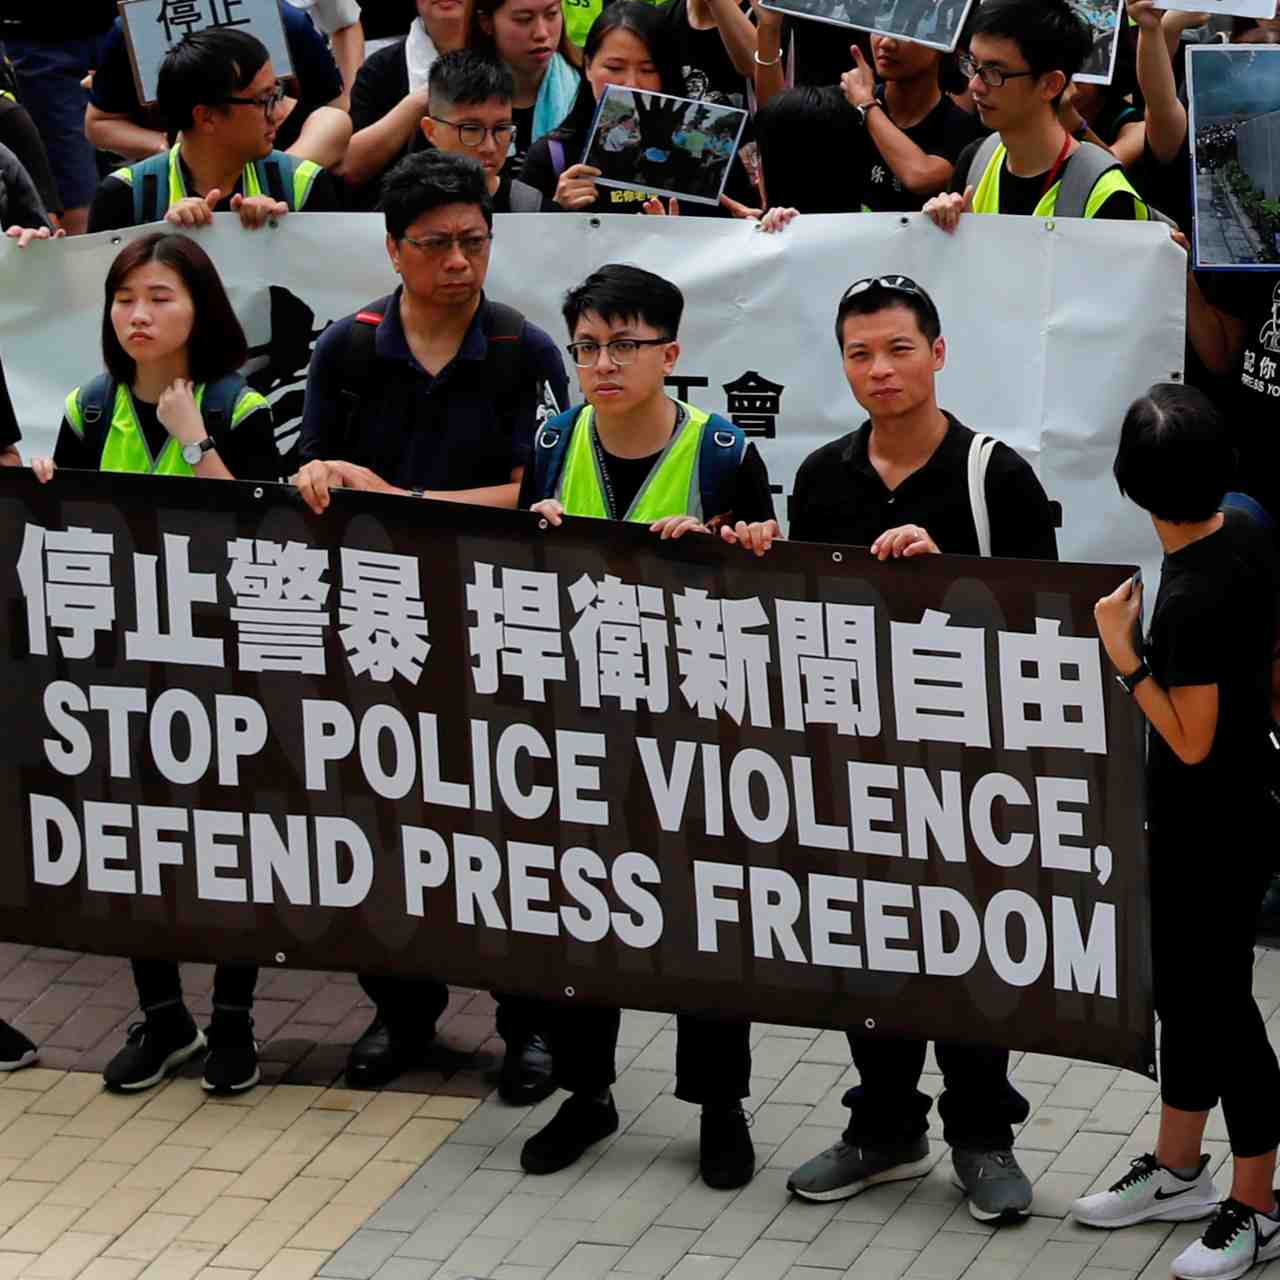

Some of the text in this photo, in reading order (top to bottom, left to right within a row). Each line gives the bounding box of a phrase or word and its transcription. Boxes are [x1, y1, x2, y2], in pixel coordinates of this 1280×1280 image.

[15, 522, 1108, 754] 停止警暴 捍衛新聞自由
[42, 679, 1113, 885] STOP POLICE VIOLENCE,
[28, 792, 1118, 999] DEFEND PRESS FREEDOM
